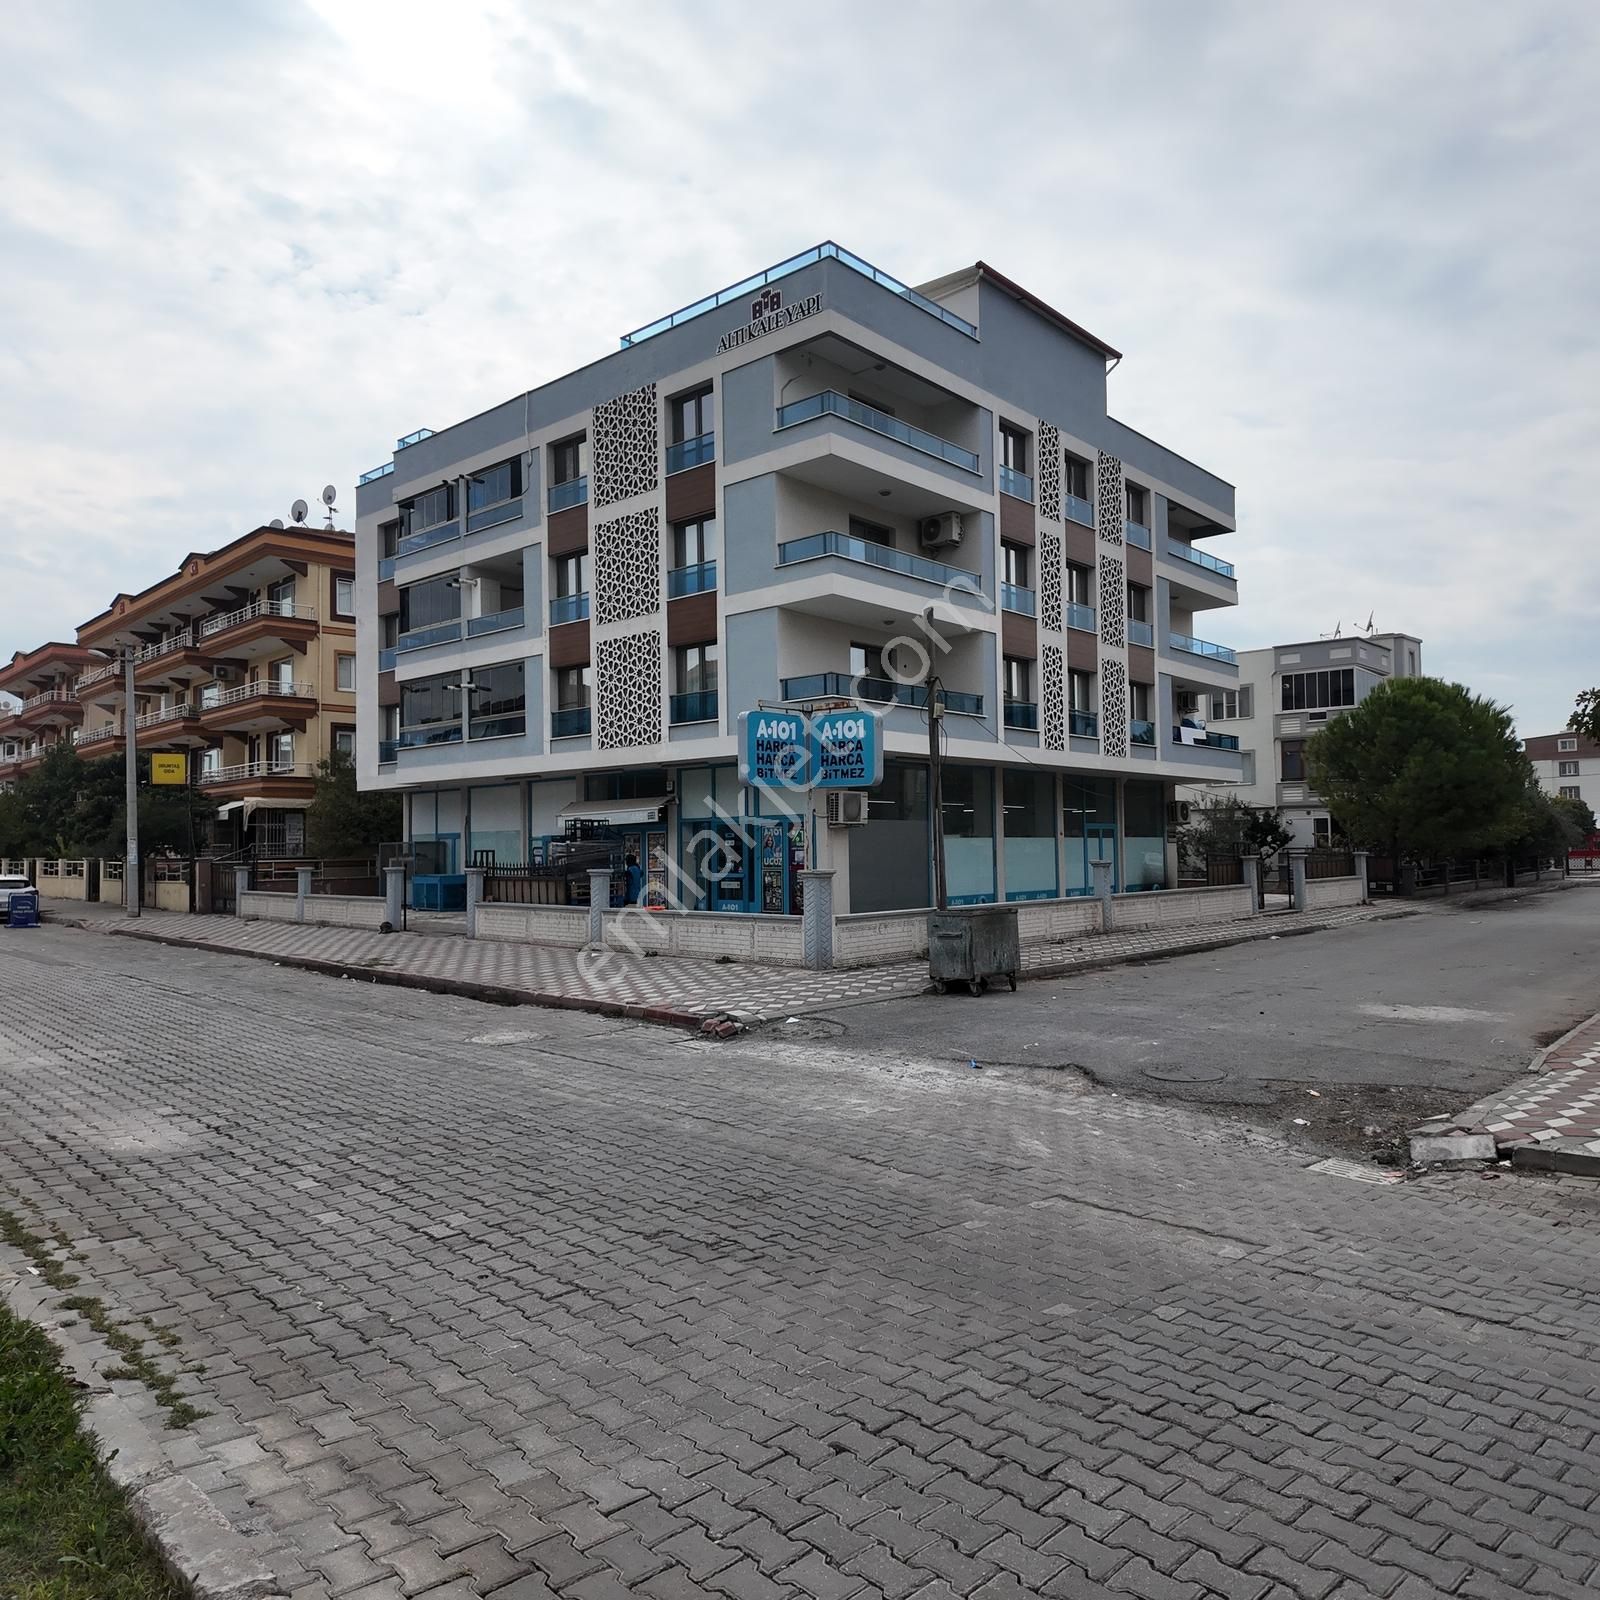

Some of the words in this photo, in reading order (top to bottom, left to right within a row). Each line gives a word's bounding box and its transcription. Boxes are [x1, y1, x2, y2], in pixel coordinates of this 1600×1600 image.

[784, 293, 823, 323] YAPI
[756, 739, 796, 754] HARCA
[820, 740, 864, 754] HARCA
[756, 752, 797, 766] HARCA
[820, 752, 864, 767] HARCA
